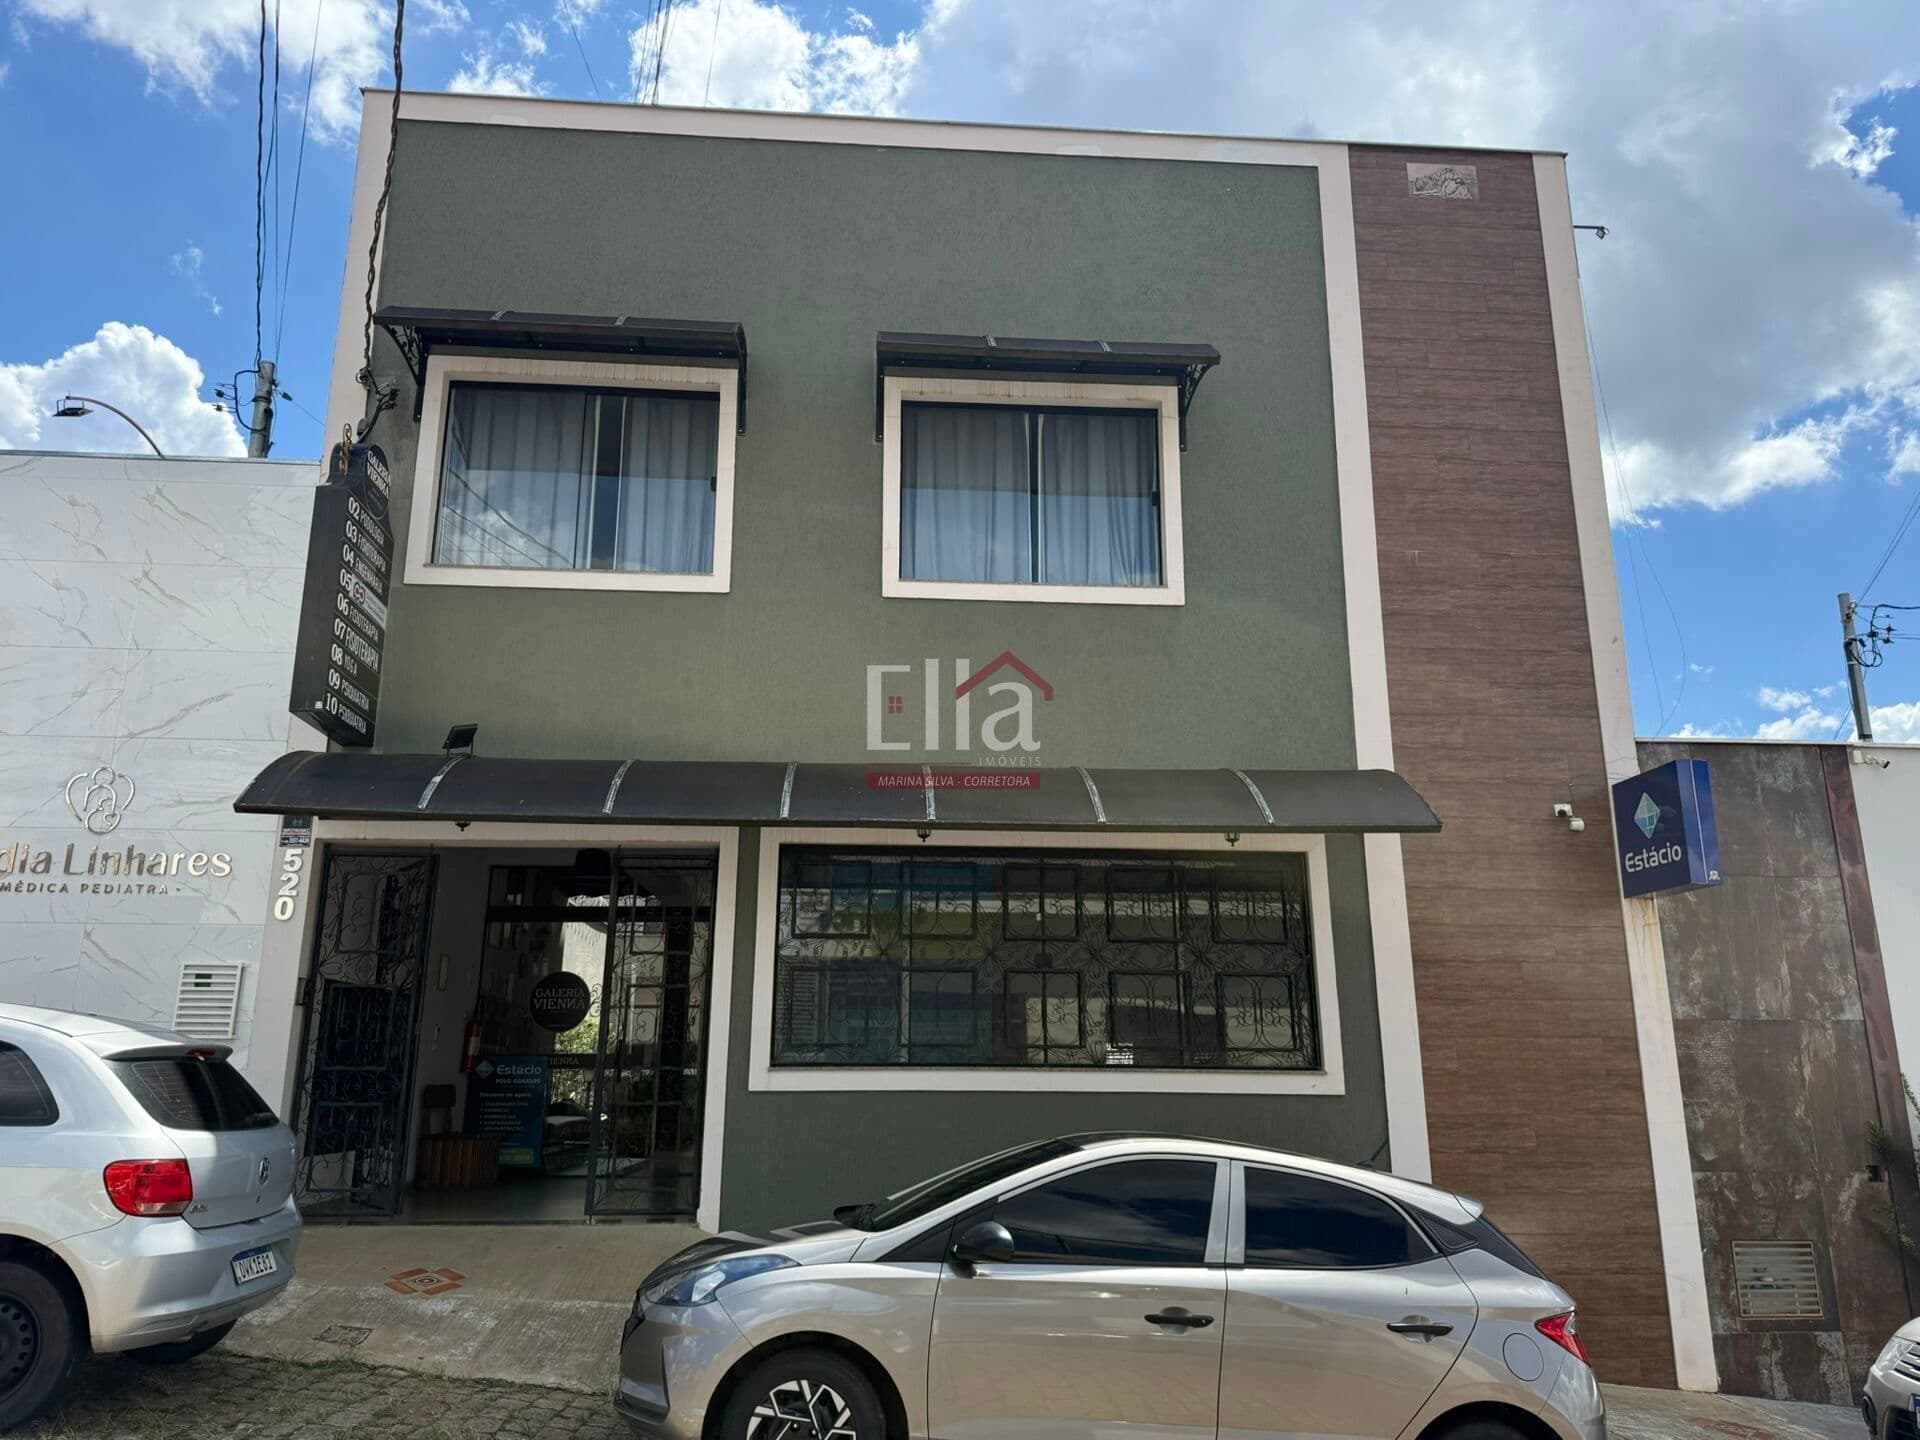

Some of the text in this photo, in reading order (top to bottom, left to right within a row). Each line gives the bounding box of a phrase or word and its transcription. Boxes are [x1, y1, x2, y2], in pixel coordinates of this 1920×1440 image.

[348, 496, 360, 521] 02
[342, 544, 354, 567] 04
[345, 520, 358, 543] 03
[357, 533, 386, 573] FISIOTERAPIA
[339, 568, 352, 592] 05
[337, 593, 349, 616] 06
[349, 606, 379, 643] FISIOTERAPIA
[331, 643, 343, 666] 08
[334, 618, 379, 673] 07 FISIOTERAPIA
[328, 668, 340, 690] 09
[325, 693, 338, 715] 10
[63, 843, 232, 877] Linhares
[1625, 842, 1682, 873] Estácio
[80, 882, 168, 895] PEDIATRA
[535, 987, 585, 998] GALERIA
